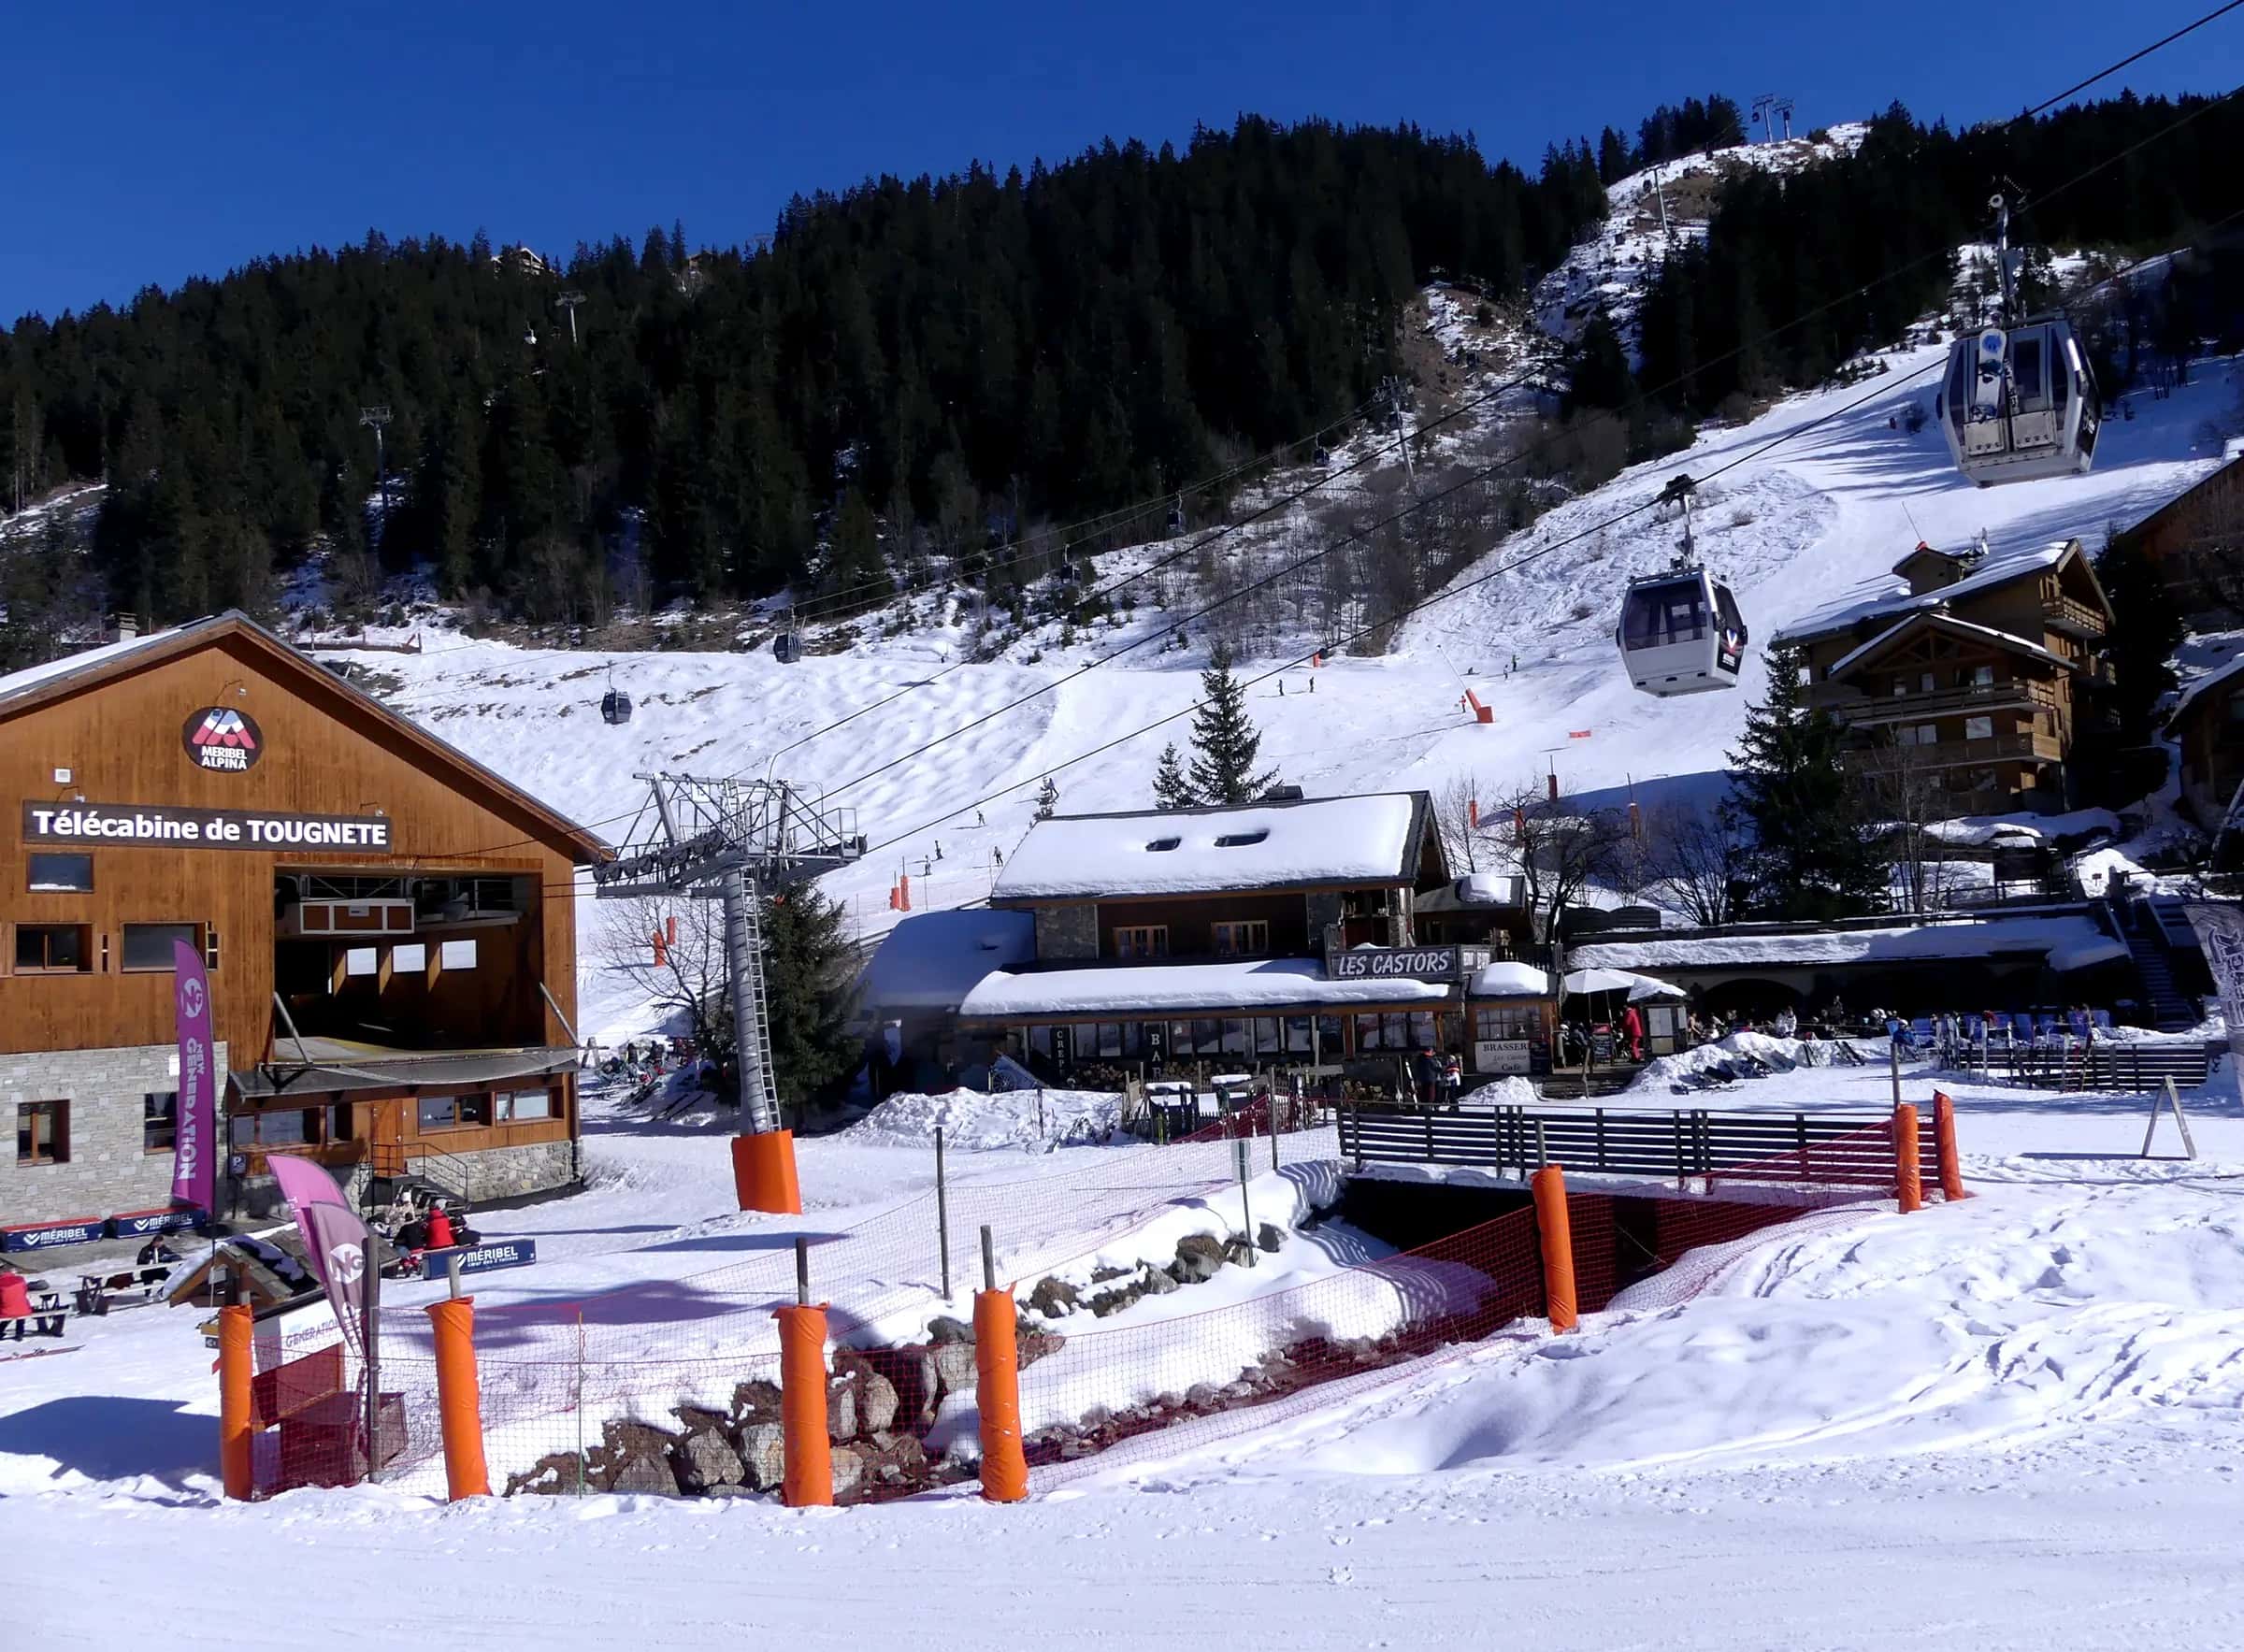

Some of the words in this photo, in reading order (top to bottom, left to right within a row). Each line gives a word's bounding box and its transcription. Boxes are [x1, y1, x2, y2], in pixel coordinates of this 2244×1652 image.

[201, 745, 248, 760] MERIBEL
[201, 755, 248, 769] ALPINA
[32, 809, 199, 840] Télécabine
[205, 817, 240, 841] de
[246, 819, 387, 845] TOUGNETE
[1338, 955, 1367, 975] LES
[1372, 951, 1450, 974] CASTORS
[1151, 1033, 1162, 1081] BAR
[178, 1037, 197, 1180] GENERATION
[150, 1214, 194, 1227] MÉRIBEL
[40, 1228, 89, 1242] MÉRIBEL
[467, 1245, 519, 1263] MÉRIBEL
